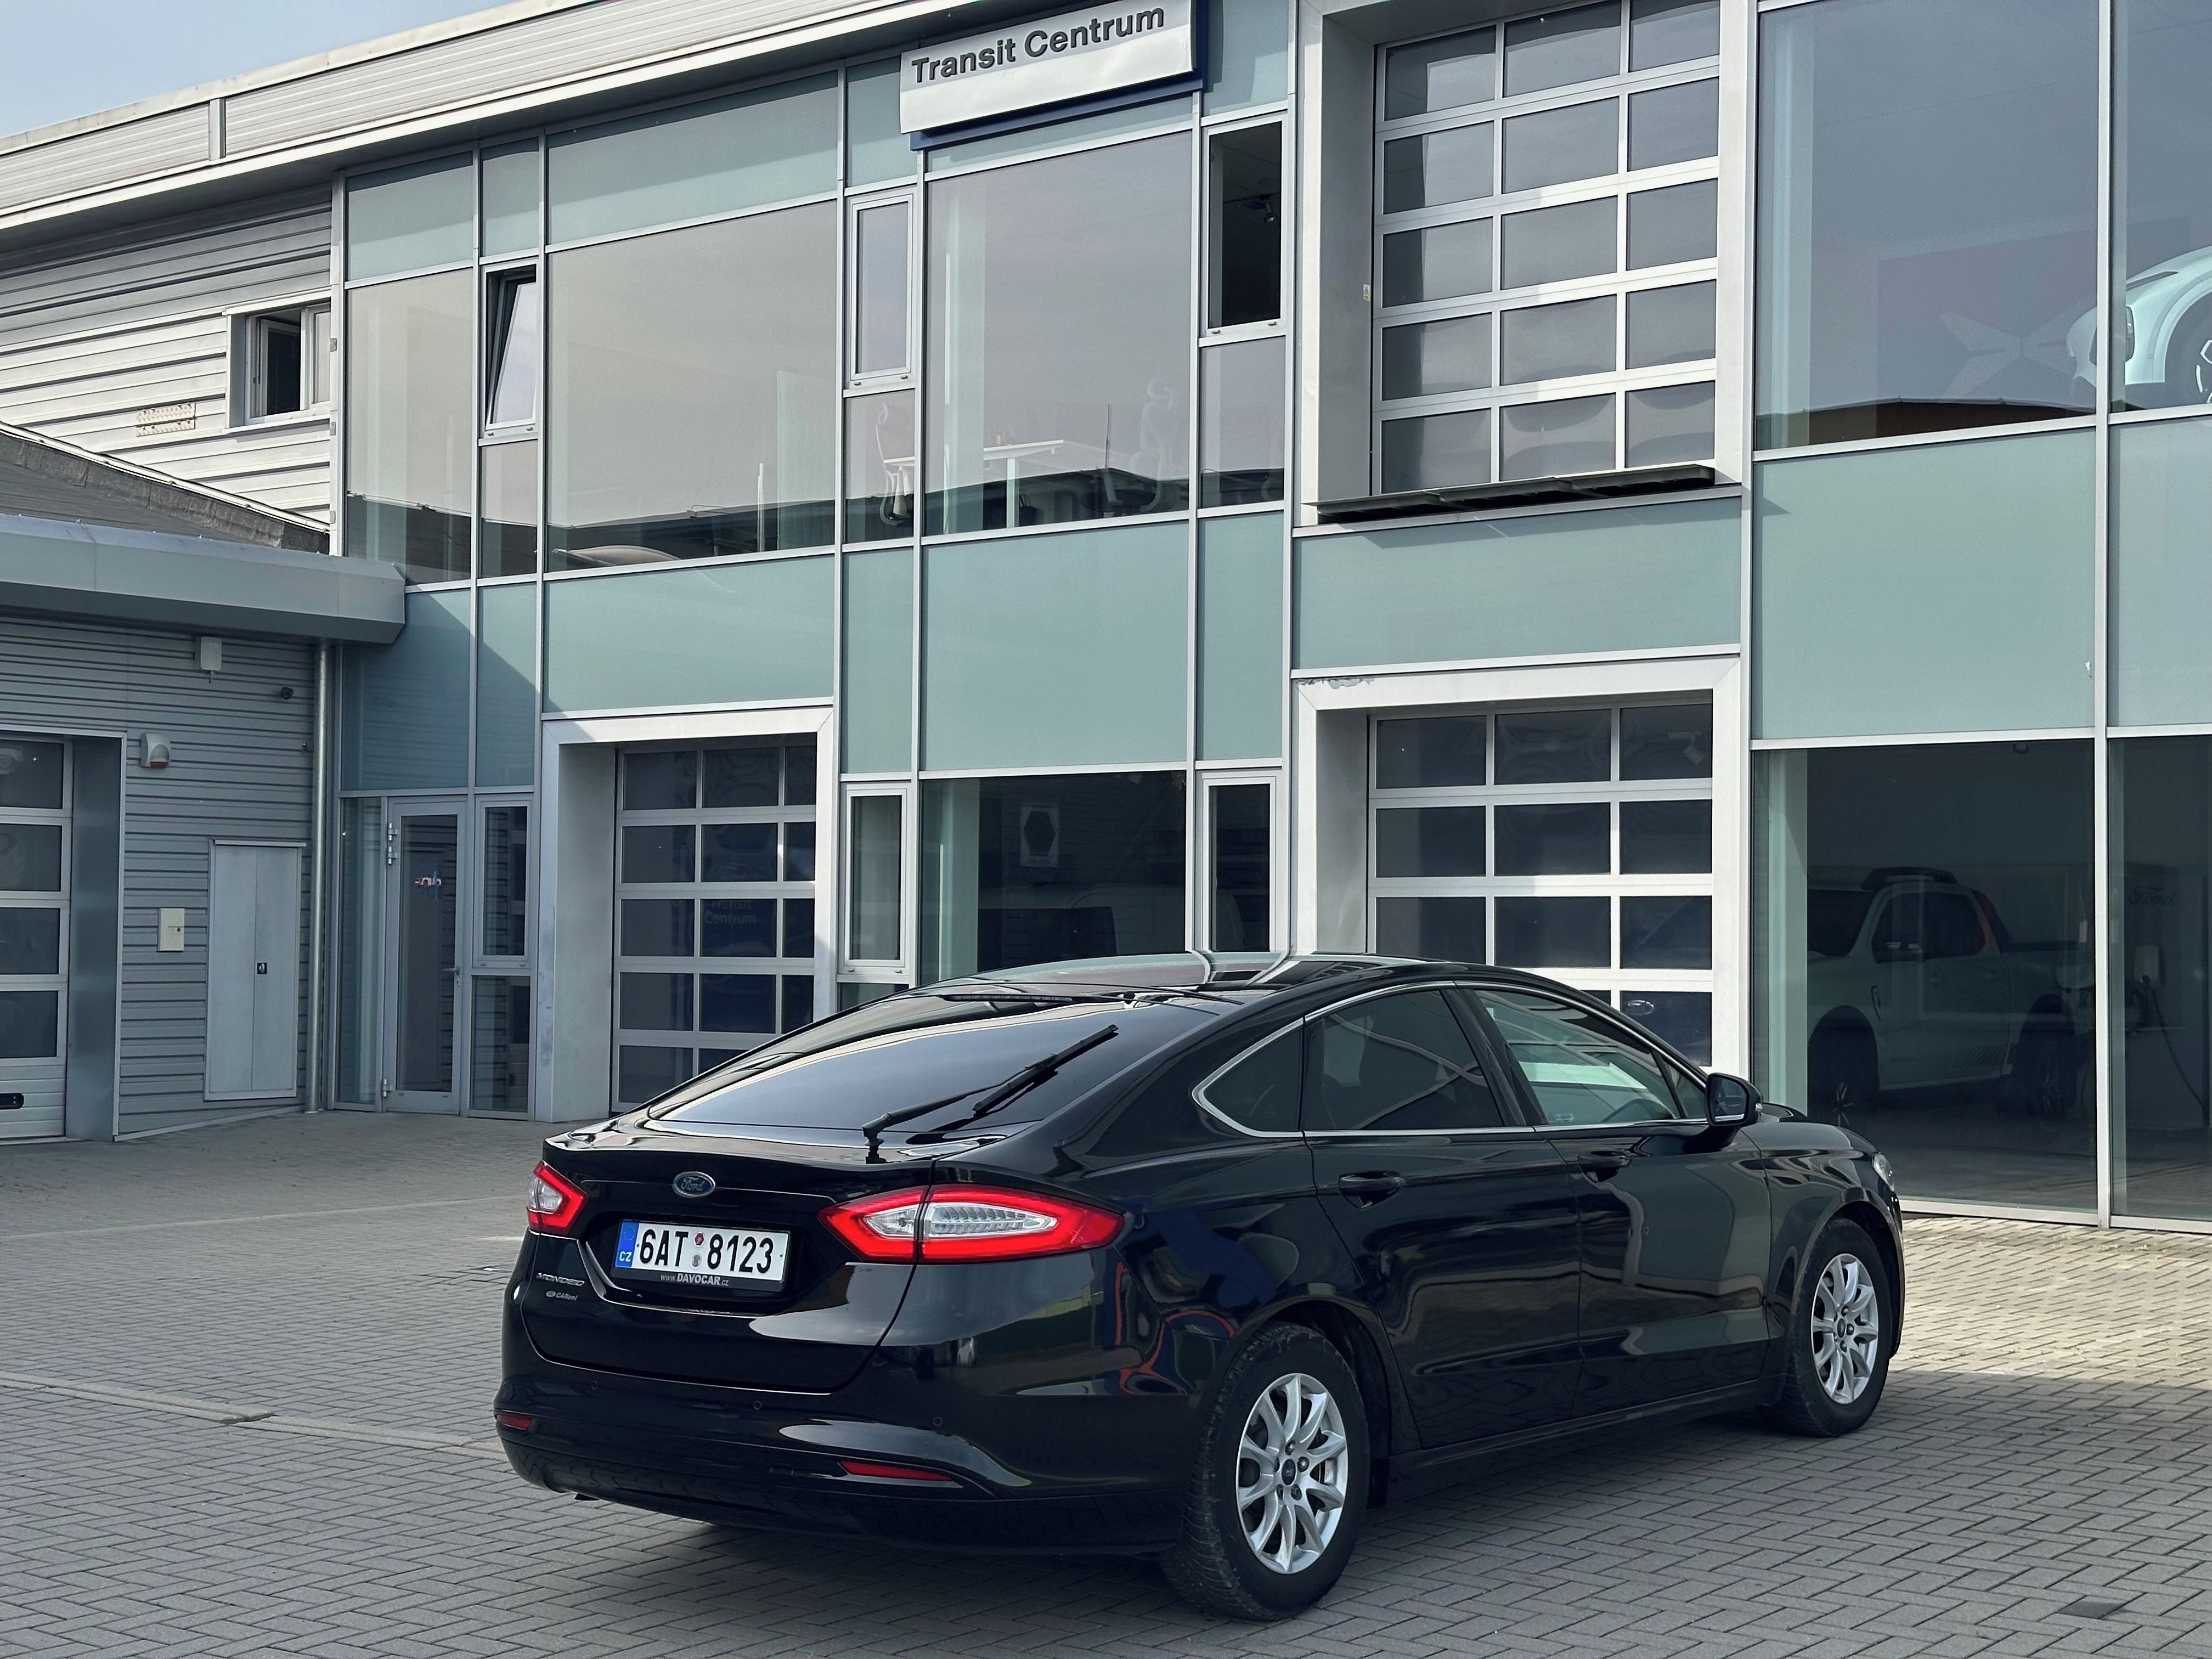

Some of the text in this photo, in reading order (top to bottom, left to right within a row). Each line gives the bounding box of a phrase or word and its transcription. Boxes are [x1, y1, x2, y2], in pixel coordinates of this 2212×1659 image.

[911, 7, 1164, 83] Transit Centrum
[619, 1251, 631, 1262] CZ
[640, 1229, 774, 1274] 6AT 8123
